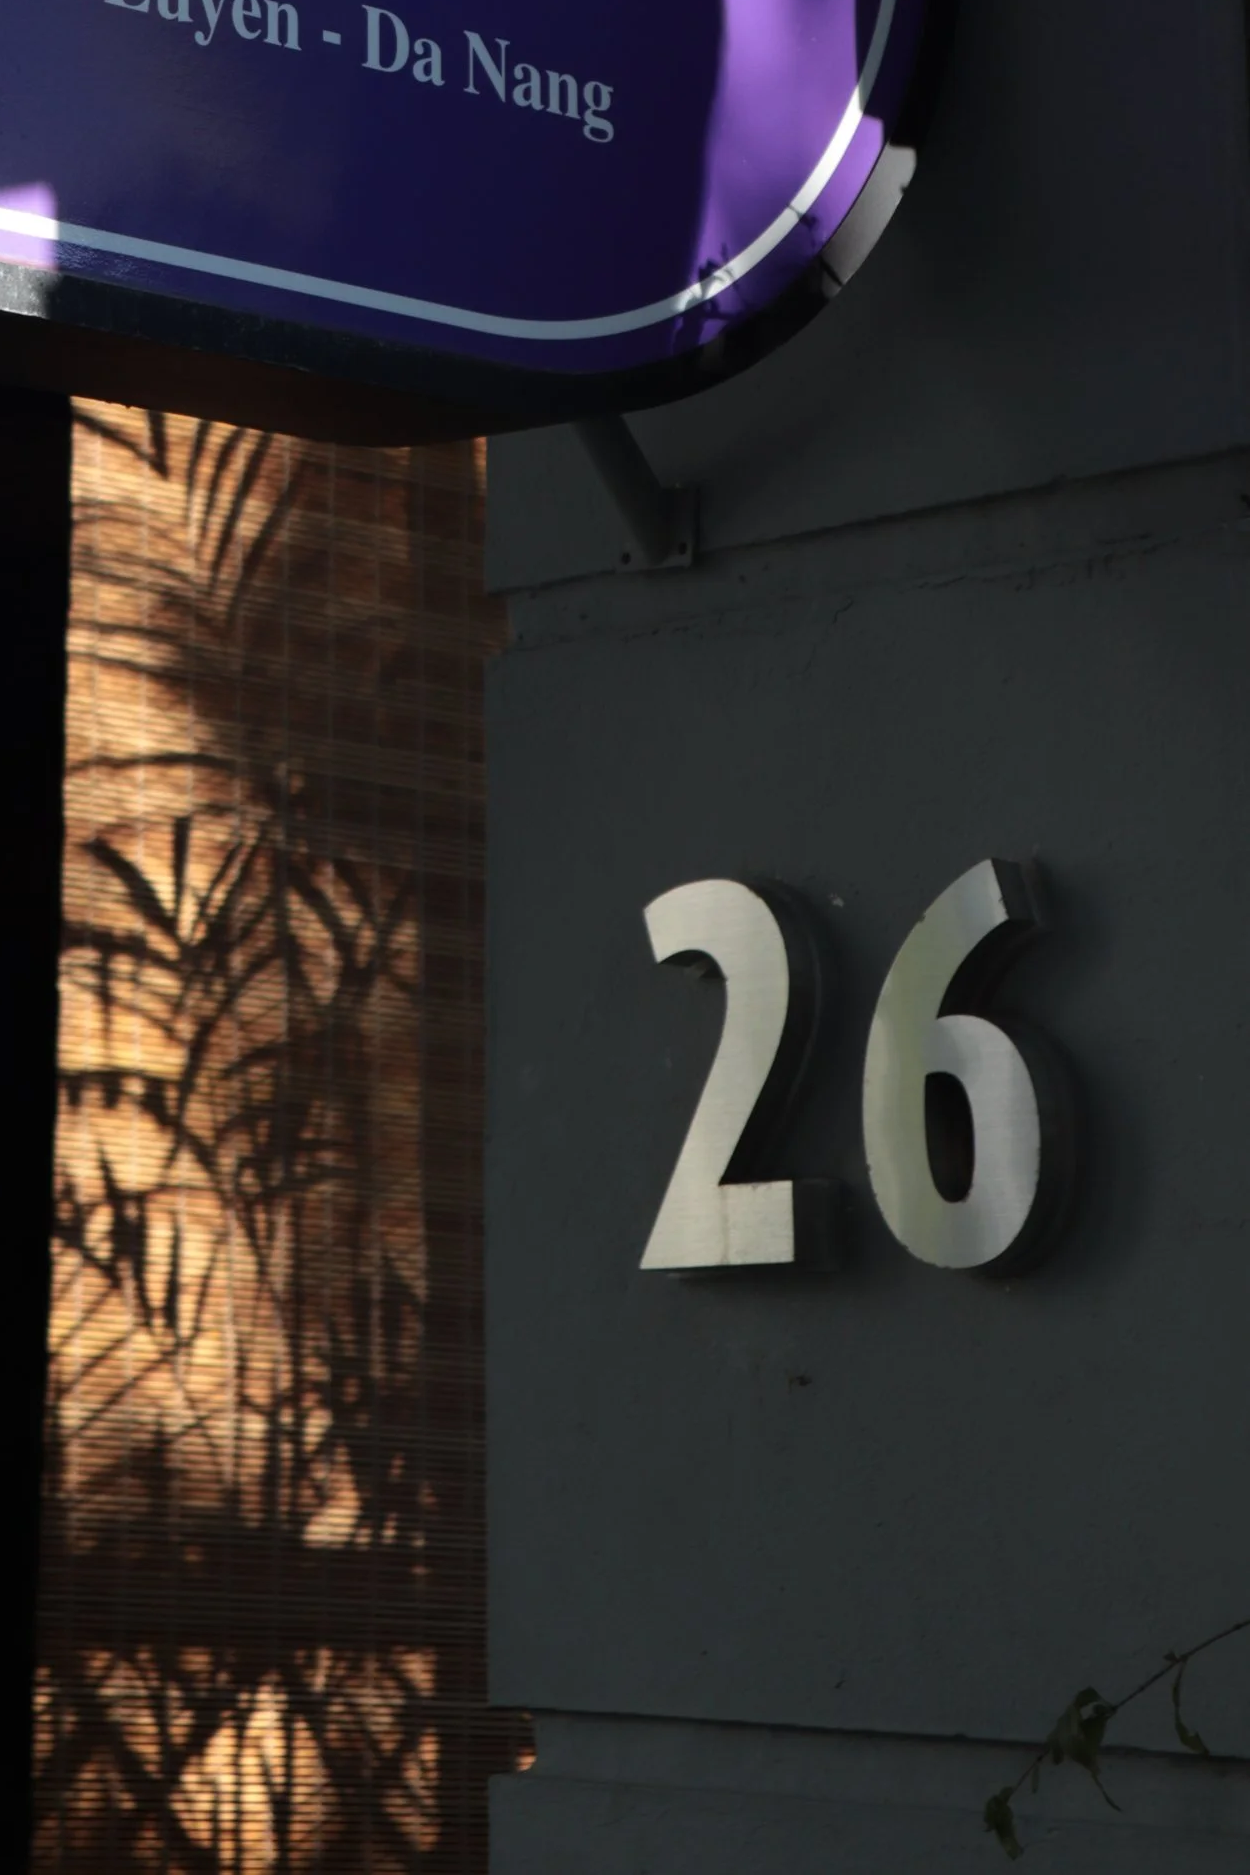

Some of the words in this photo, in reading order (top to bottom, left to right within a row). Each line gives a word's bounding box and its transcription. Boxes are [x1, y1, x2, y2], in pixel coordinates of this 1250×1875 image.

[322, 29, 342, 45] -
[361, 4, 445, 86] Da
[463, 30, 614, 143] Nang
[639, 858, 1041, 1269] 26
